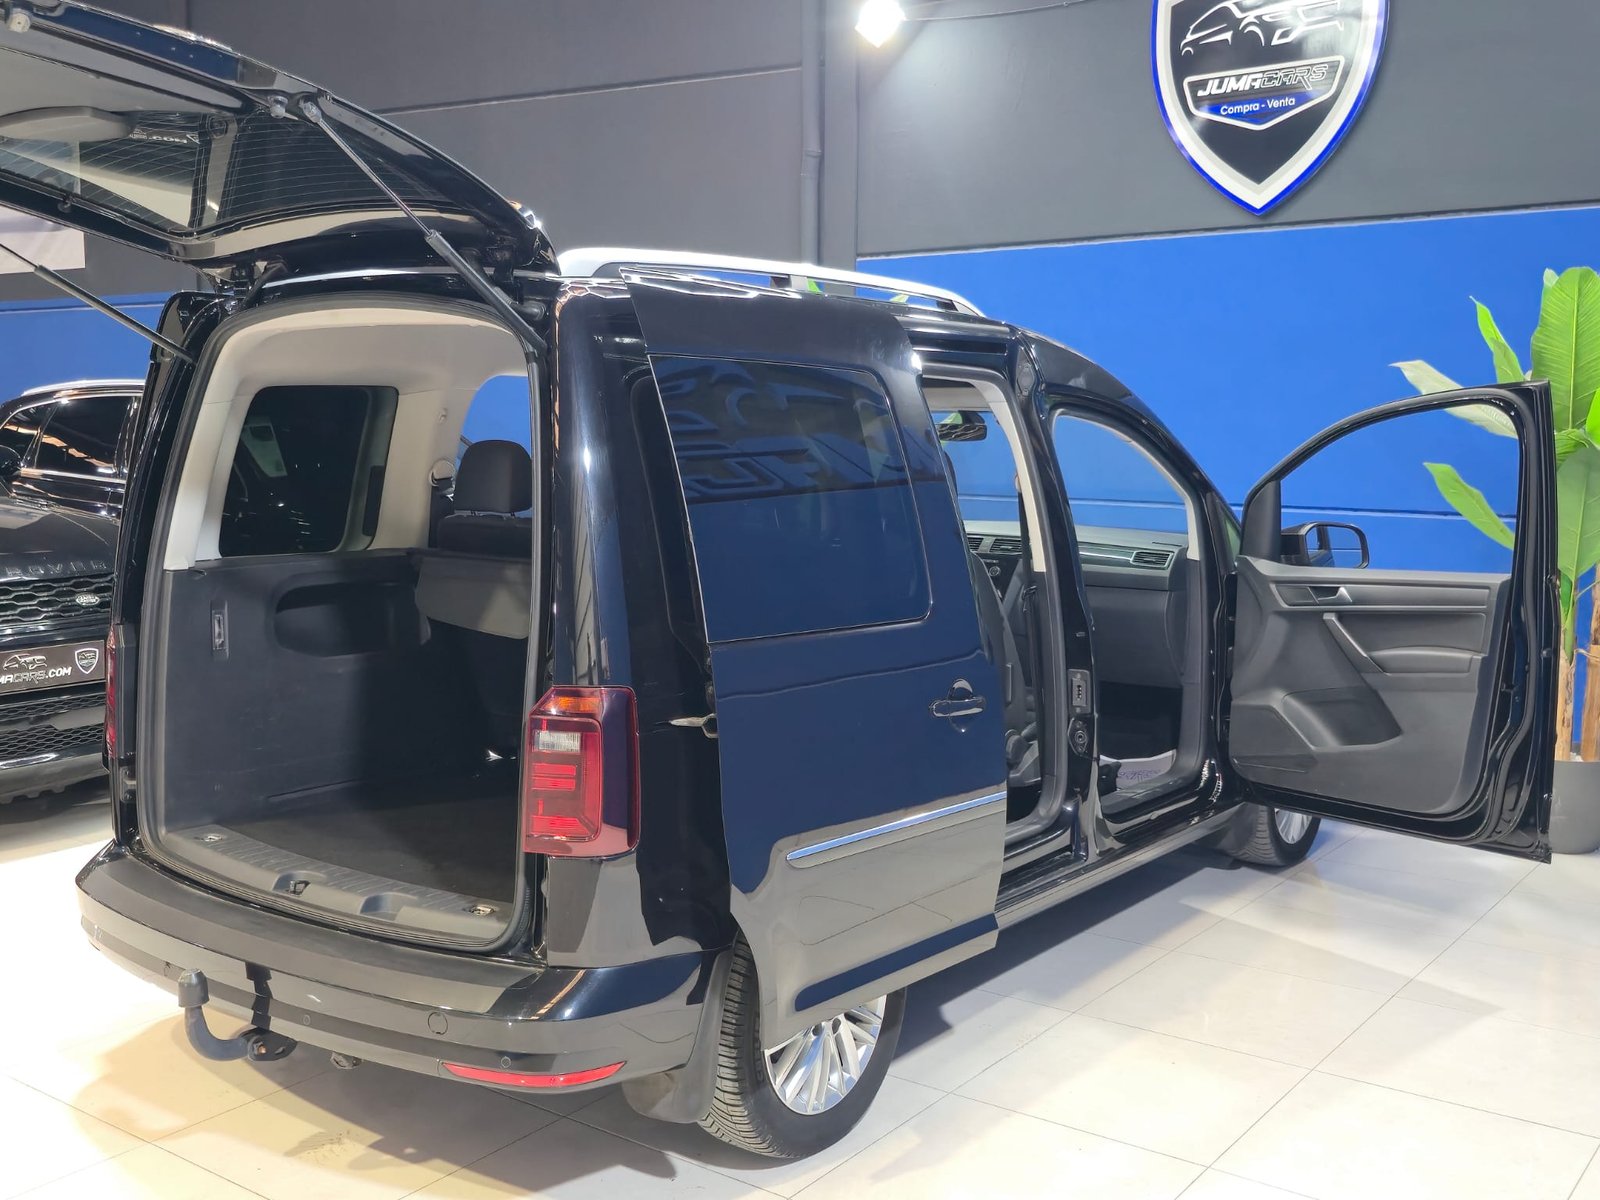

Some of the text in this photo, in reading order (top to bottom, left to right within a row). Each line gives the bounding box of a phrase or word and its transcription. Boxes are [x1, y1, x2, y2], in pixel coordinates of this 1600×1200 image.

[1197, 64, 1328, 97] JUMACARS
[1220, 102, 1260, 115] Compra
[1266, 97, 1296, 109] Venta
